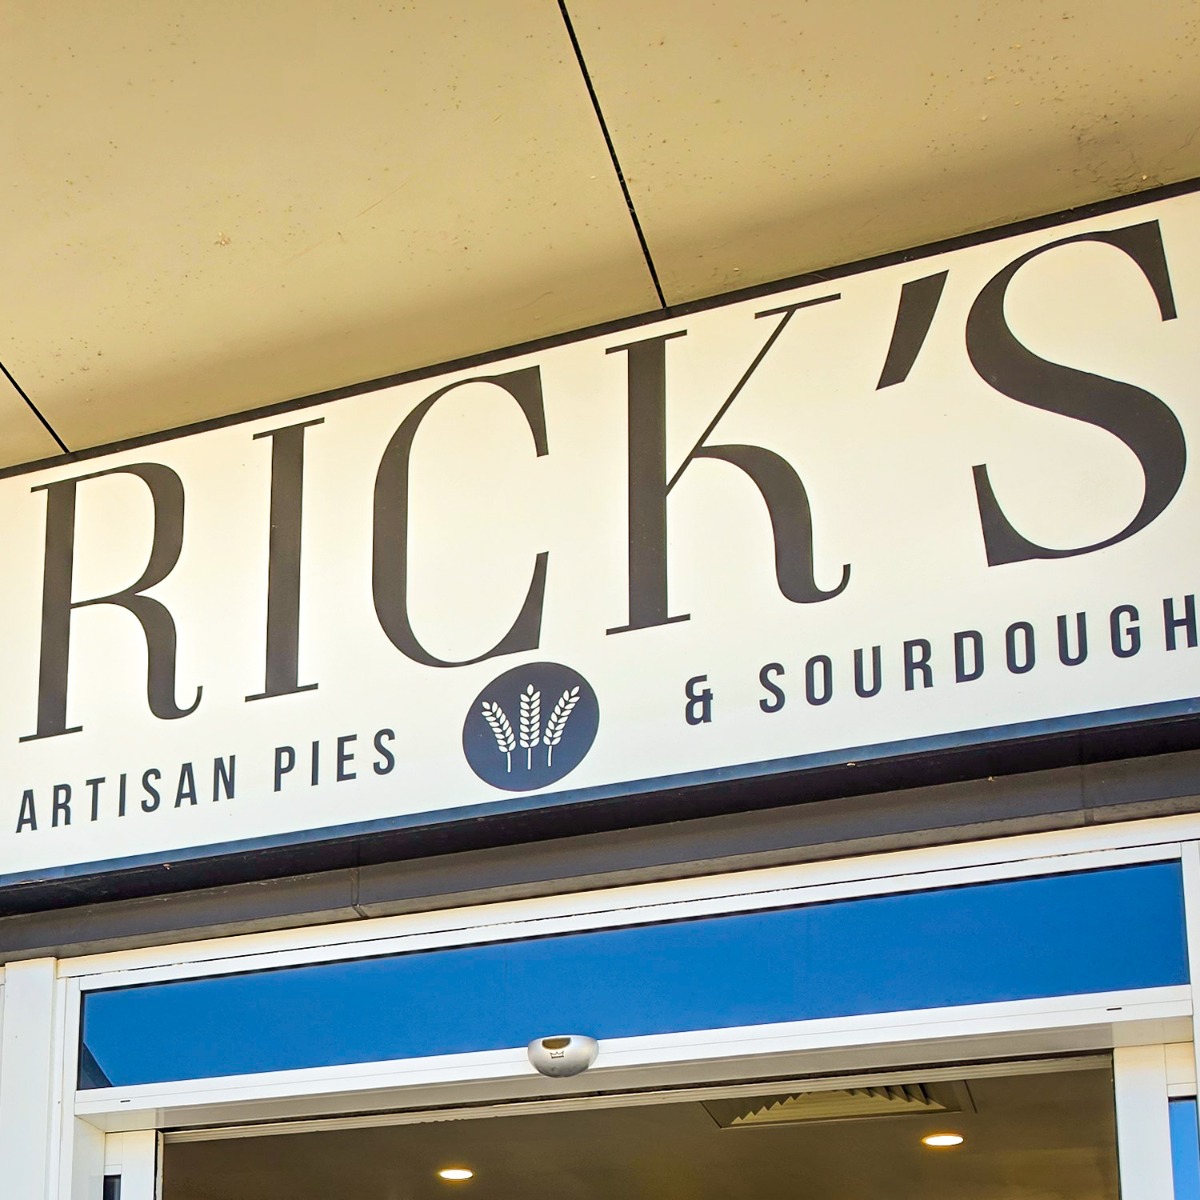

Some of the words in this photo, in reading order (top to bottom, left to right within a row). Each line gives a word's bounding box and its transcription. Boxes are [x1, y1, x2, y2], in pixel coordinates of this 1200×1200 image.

[19, 218, 1187, 743] RICK'S
[15, 754, 236, 834] ARTISAN
[274, 728, 396, 792] PIES
[685, 674, 714, 727] &
[759, 594, 1198, 714] SOURDOUGH
